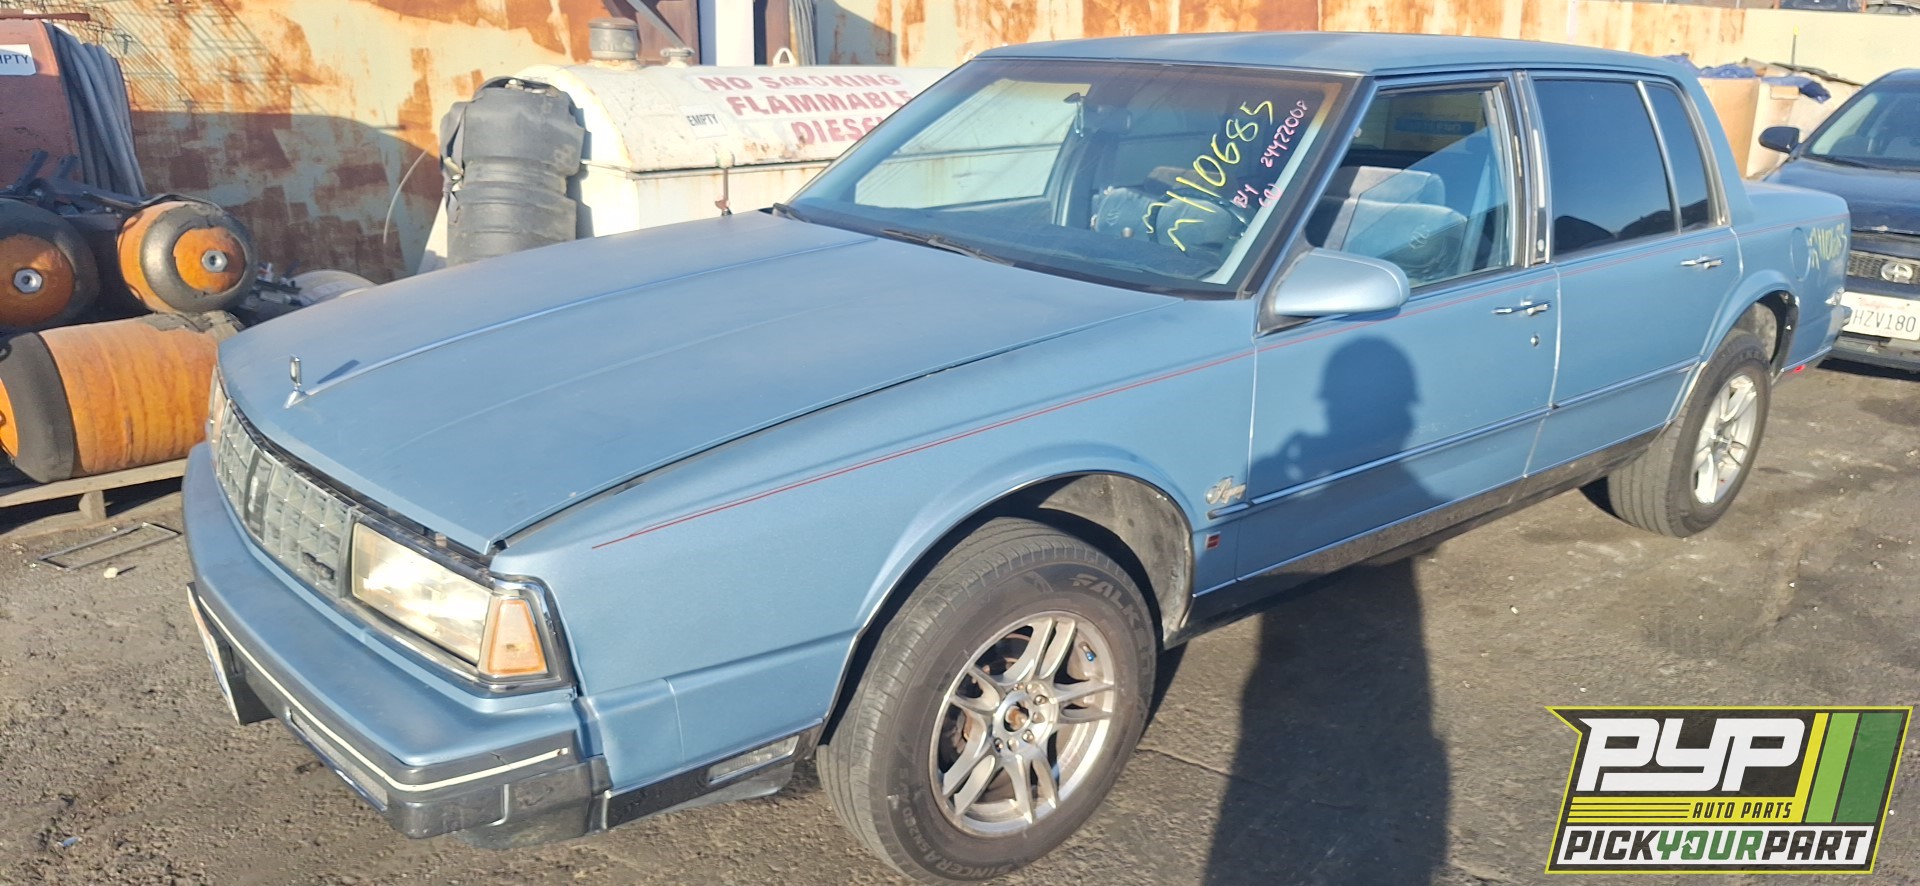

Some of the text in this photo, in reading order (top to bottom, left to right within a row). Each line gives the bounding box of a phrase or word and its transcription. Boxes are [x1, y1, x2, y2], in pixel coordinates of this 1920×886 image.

[698, 74, 902, 92] NO SMOKING
[687, 113, 719, 128] EMPTY
[790, 117, 884, 146] DIESE
